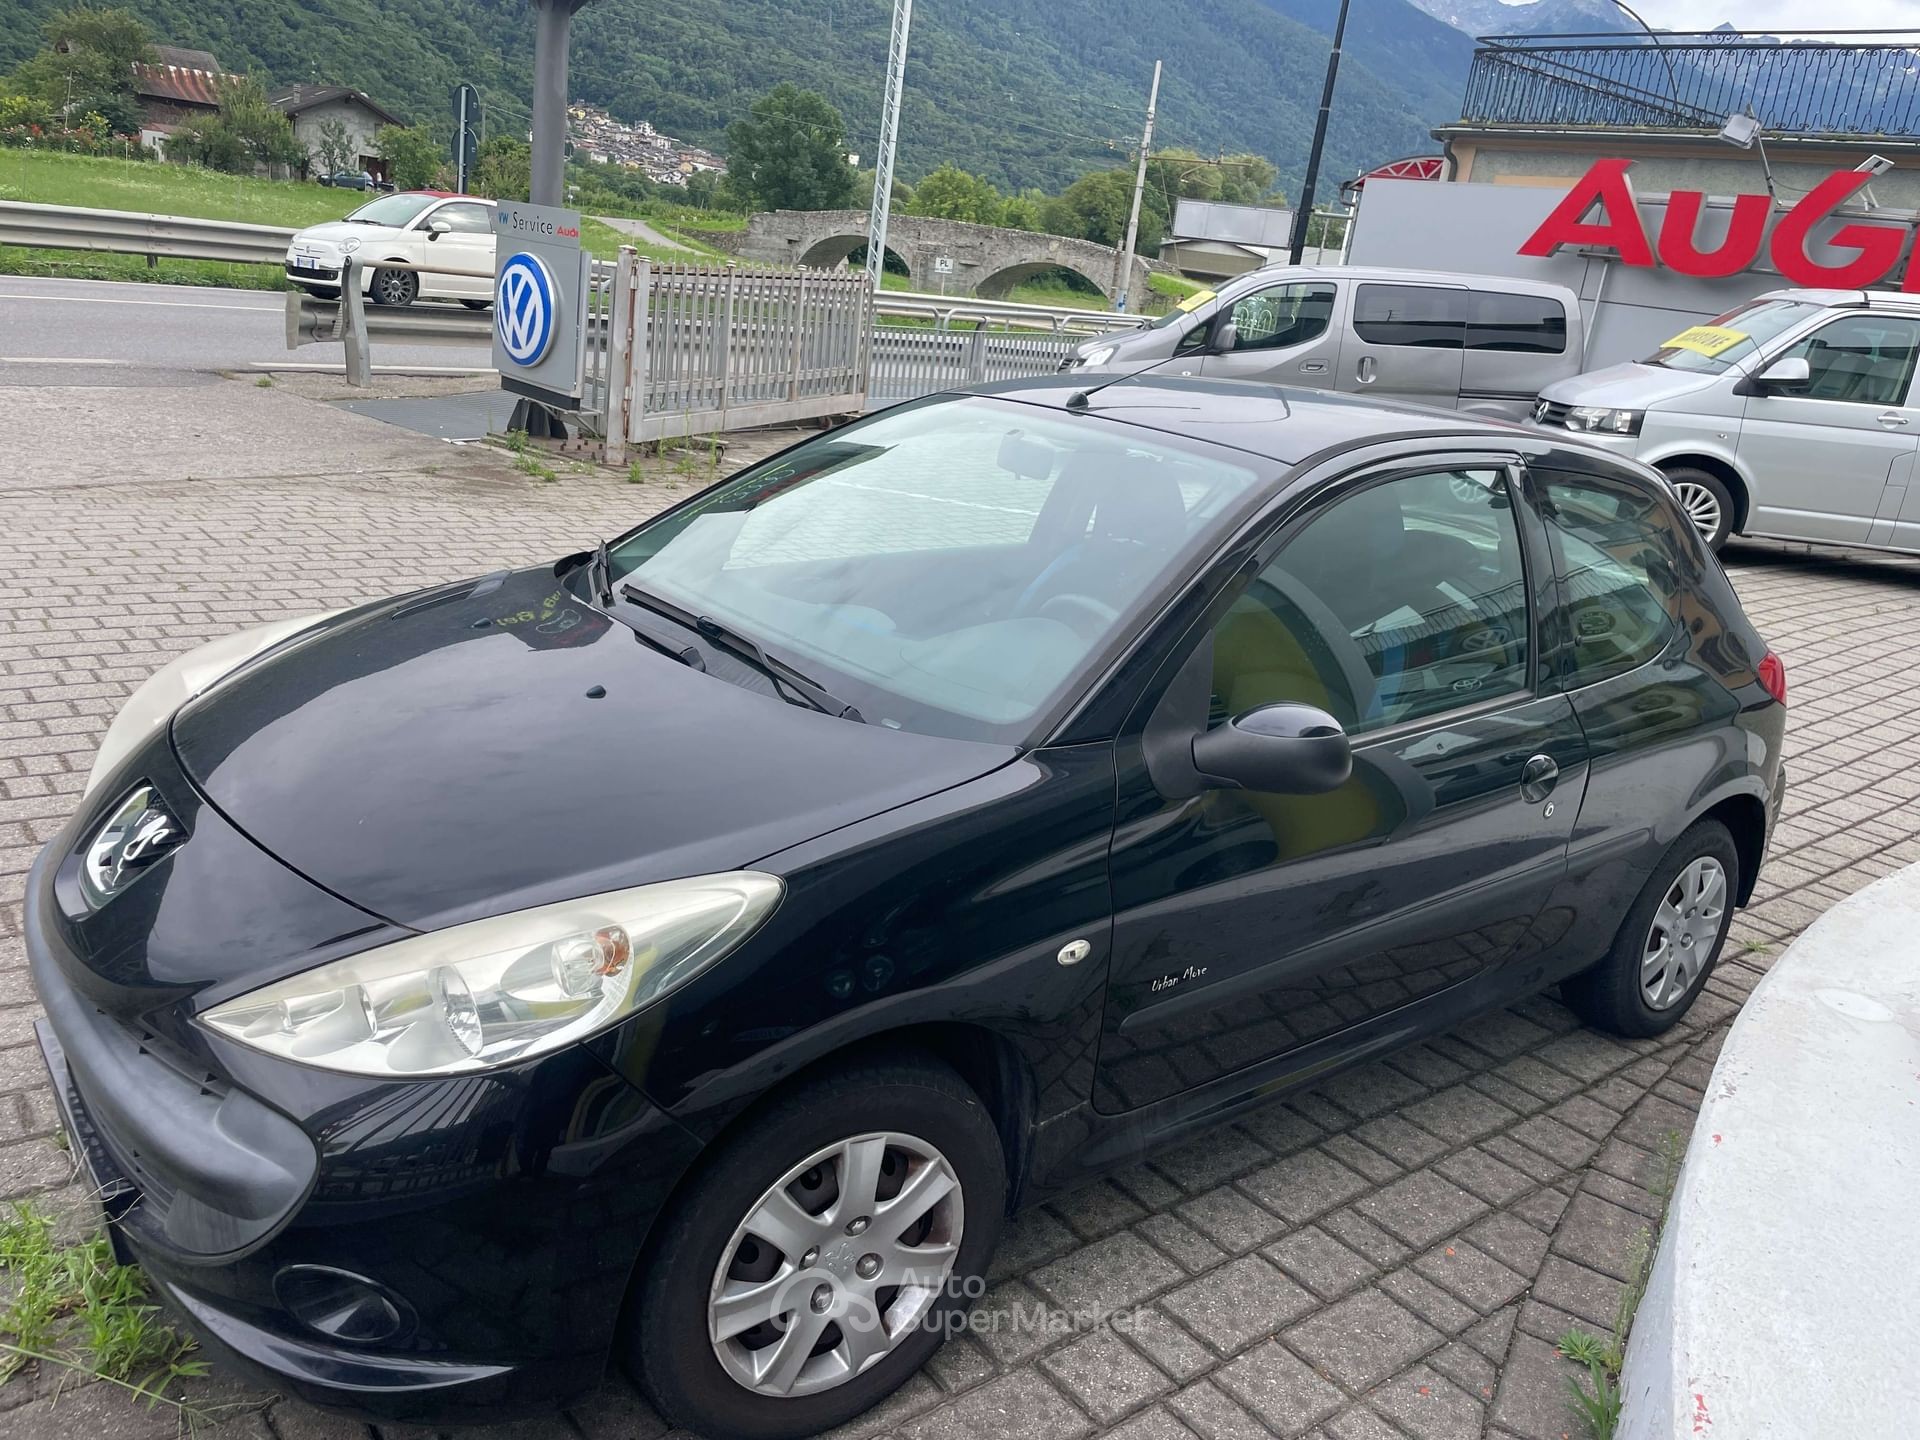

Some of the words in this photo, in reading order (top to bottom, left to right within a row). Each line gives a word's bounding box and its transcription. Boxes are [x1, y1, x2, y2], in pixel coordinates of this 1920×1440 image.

[512, 211, 553, 235] Service
[556, 225, 580, 238] Audi
[1516, 158, 1920, 293] AuG
[940, 259, 949, 267] PL
[1151, 975, 1179, 992] Urban
